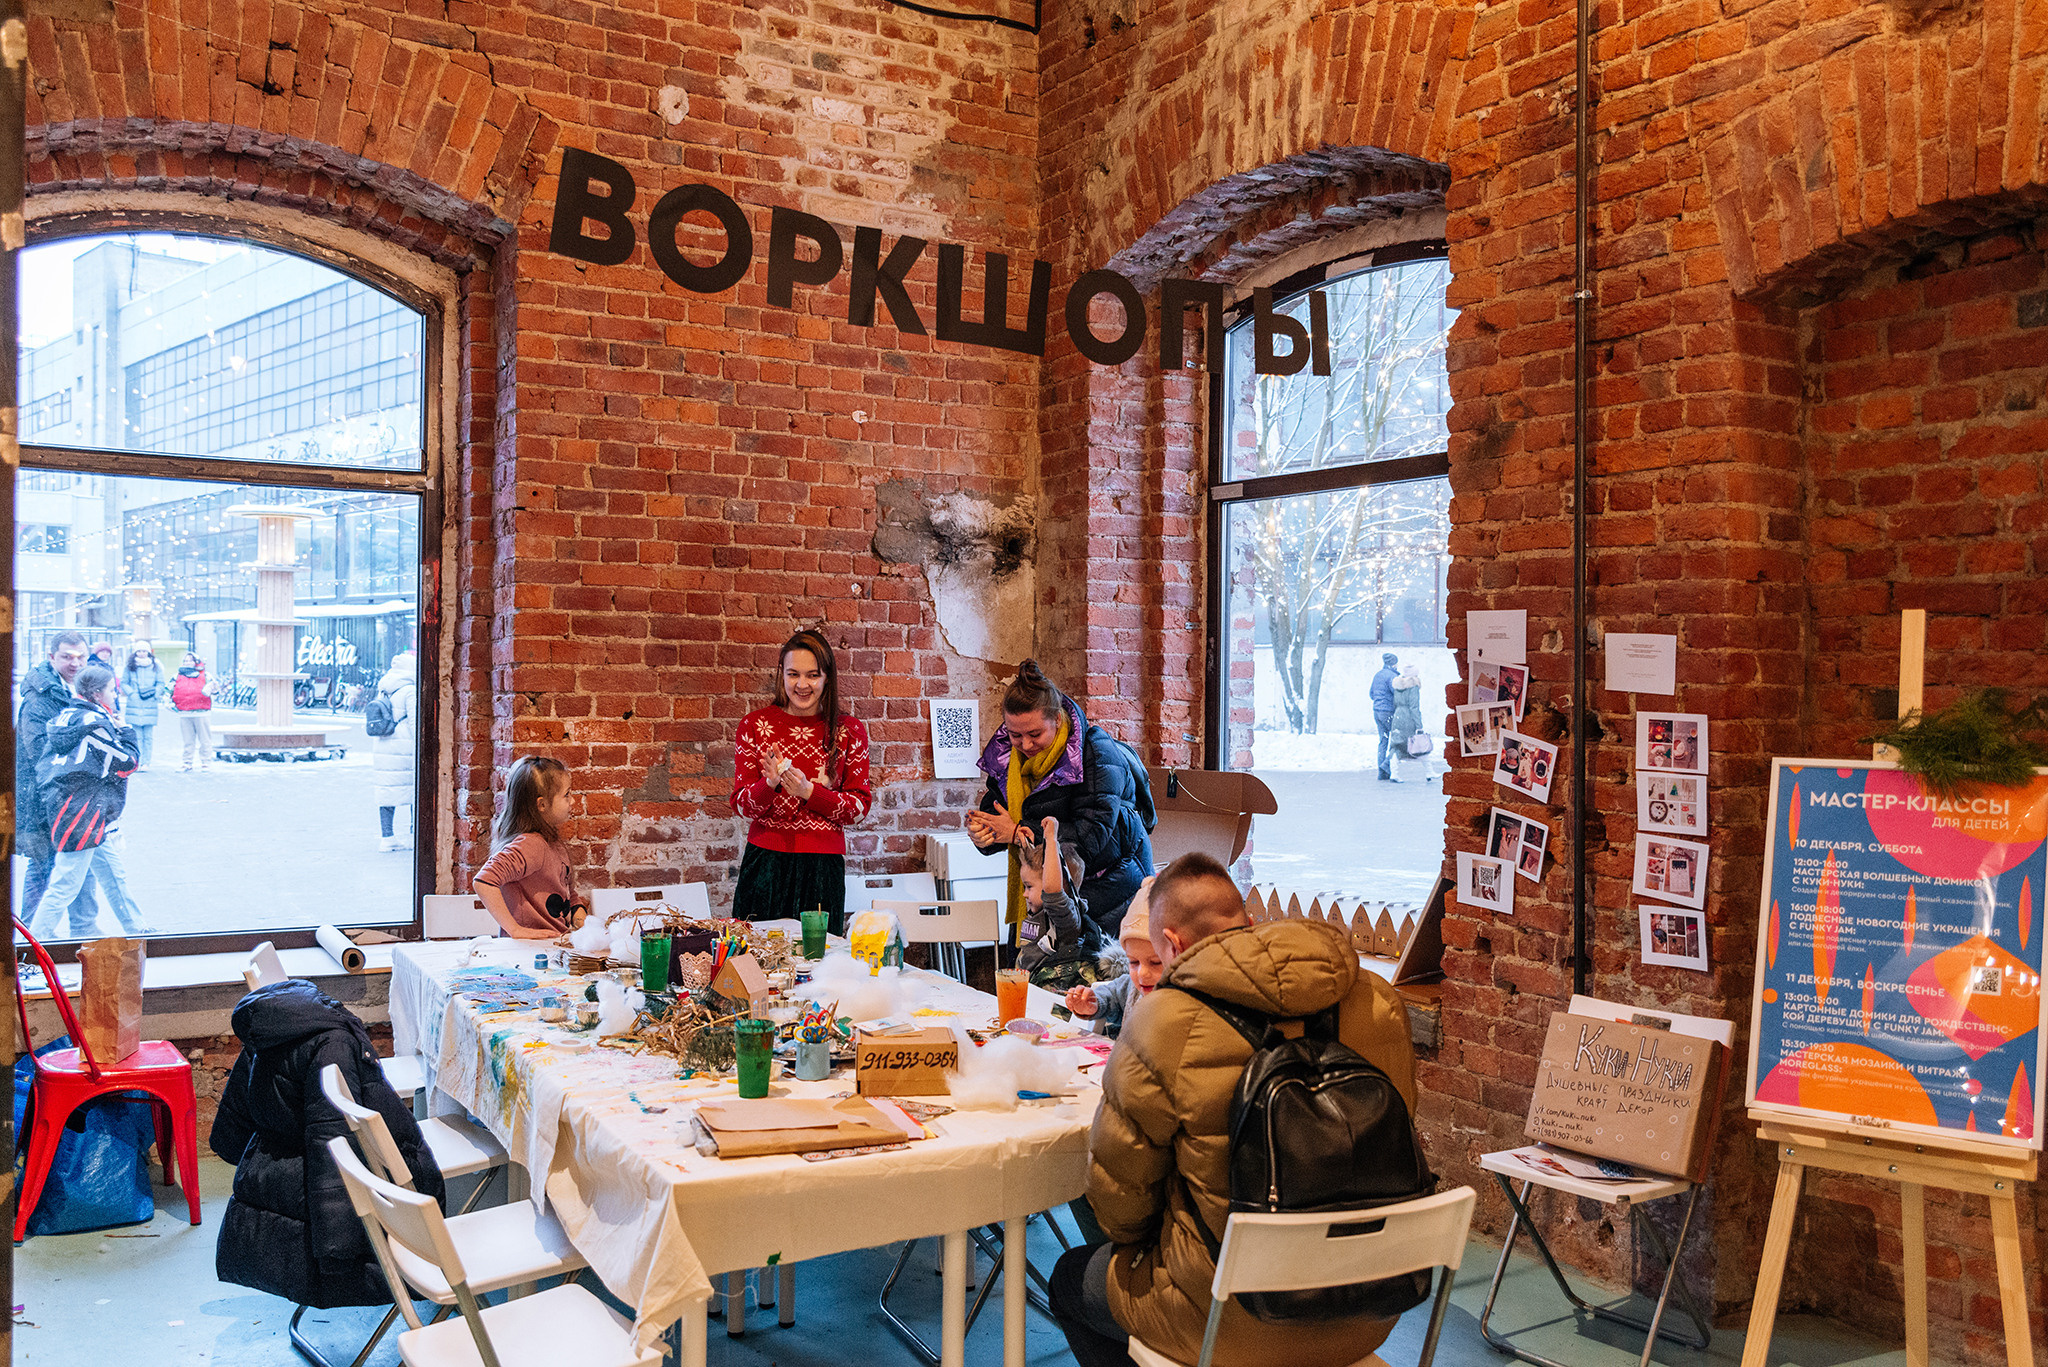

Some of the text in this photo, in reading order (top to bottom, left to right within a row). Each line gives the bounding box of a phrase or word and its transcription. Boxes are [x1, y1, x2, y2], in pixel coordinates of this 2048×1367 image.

[549, 146, 1331, 377] ВОРКШОПЫ
[1809, 791, 2010, 815] МАСТЕР-КЛАССЫ
[1932, 817, 2010, 831] ДЛЯ ДЕТЕЙ
[1795, 838, 1923, 855] 10 ДЕКАБРЯ, СУББОТА
[1793, 858, 1849, 869] 12:00-16:00
[1792, 877, 1865, 889] С КУКИ-НУКИ:
[1793, 867, 1860, 879] МАСТЕРСКАЯ
[1862, 872, 1931, 884] ВОЛШЕБНЫХ
[1830, 890, 1876, 899] декорируем
[1877, 892, 1896, 900] свой
[1790, 903, 1845, 915] 16:00-18:00
[1789, 922, 1856, 935] С FUNKY JAM:
[1790, 912, 2000, 937] ПОДВЕСНЫЕ НОВОГОДНИЕ УКРАШЕНЯ
[1785, 973, 1945, 997] 11 ДЕКАБРЯ, ВОСКРЕСЕНЬЕ
[1784, 992, 1839, 1005] 13:00-15:00
[1783, 1002, 2013, 1034] КАРТОННЫЕ ДОМИКИ ДЛЯ РОЖДЕСТВЕНС-
[1783, 1011, 1945, 1037] КОЙ ДЕРЕВУШКИ С FUNKY JAM:
[1781, 1039, 1834, 1052] 15:30-19:30
[1779, 1058, 1842, 1073] MOREGLASS:
[1780, 1049, 1970, 1079] МАСТЕРСКАЯ МОЗАИКИ И ВИТРАЖА
